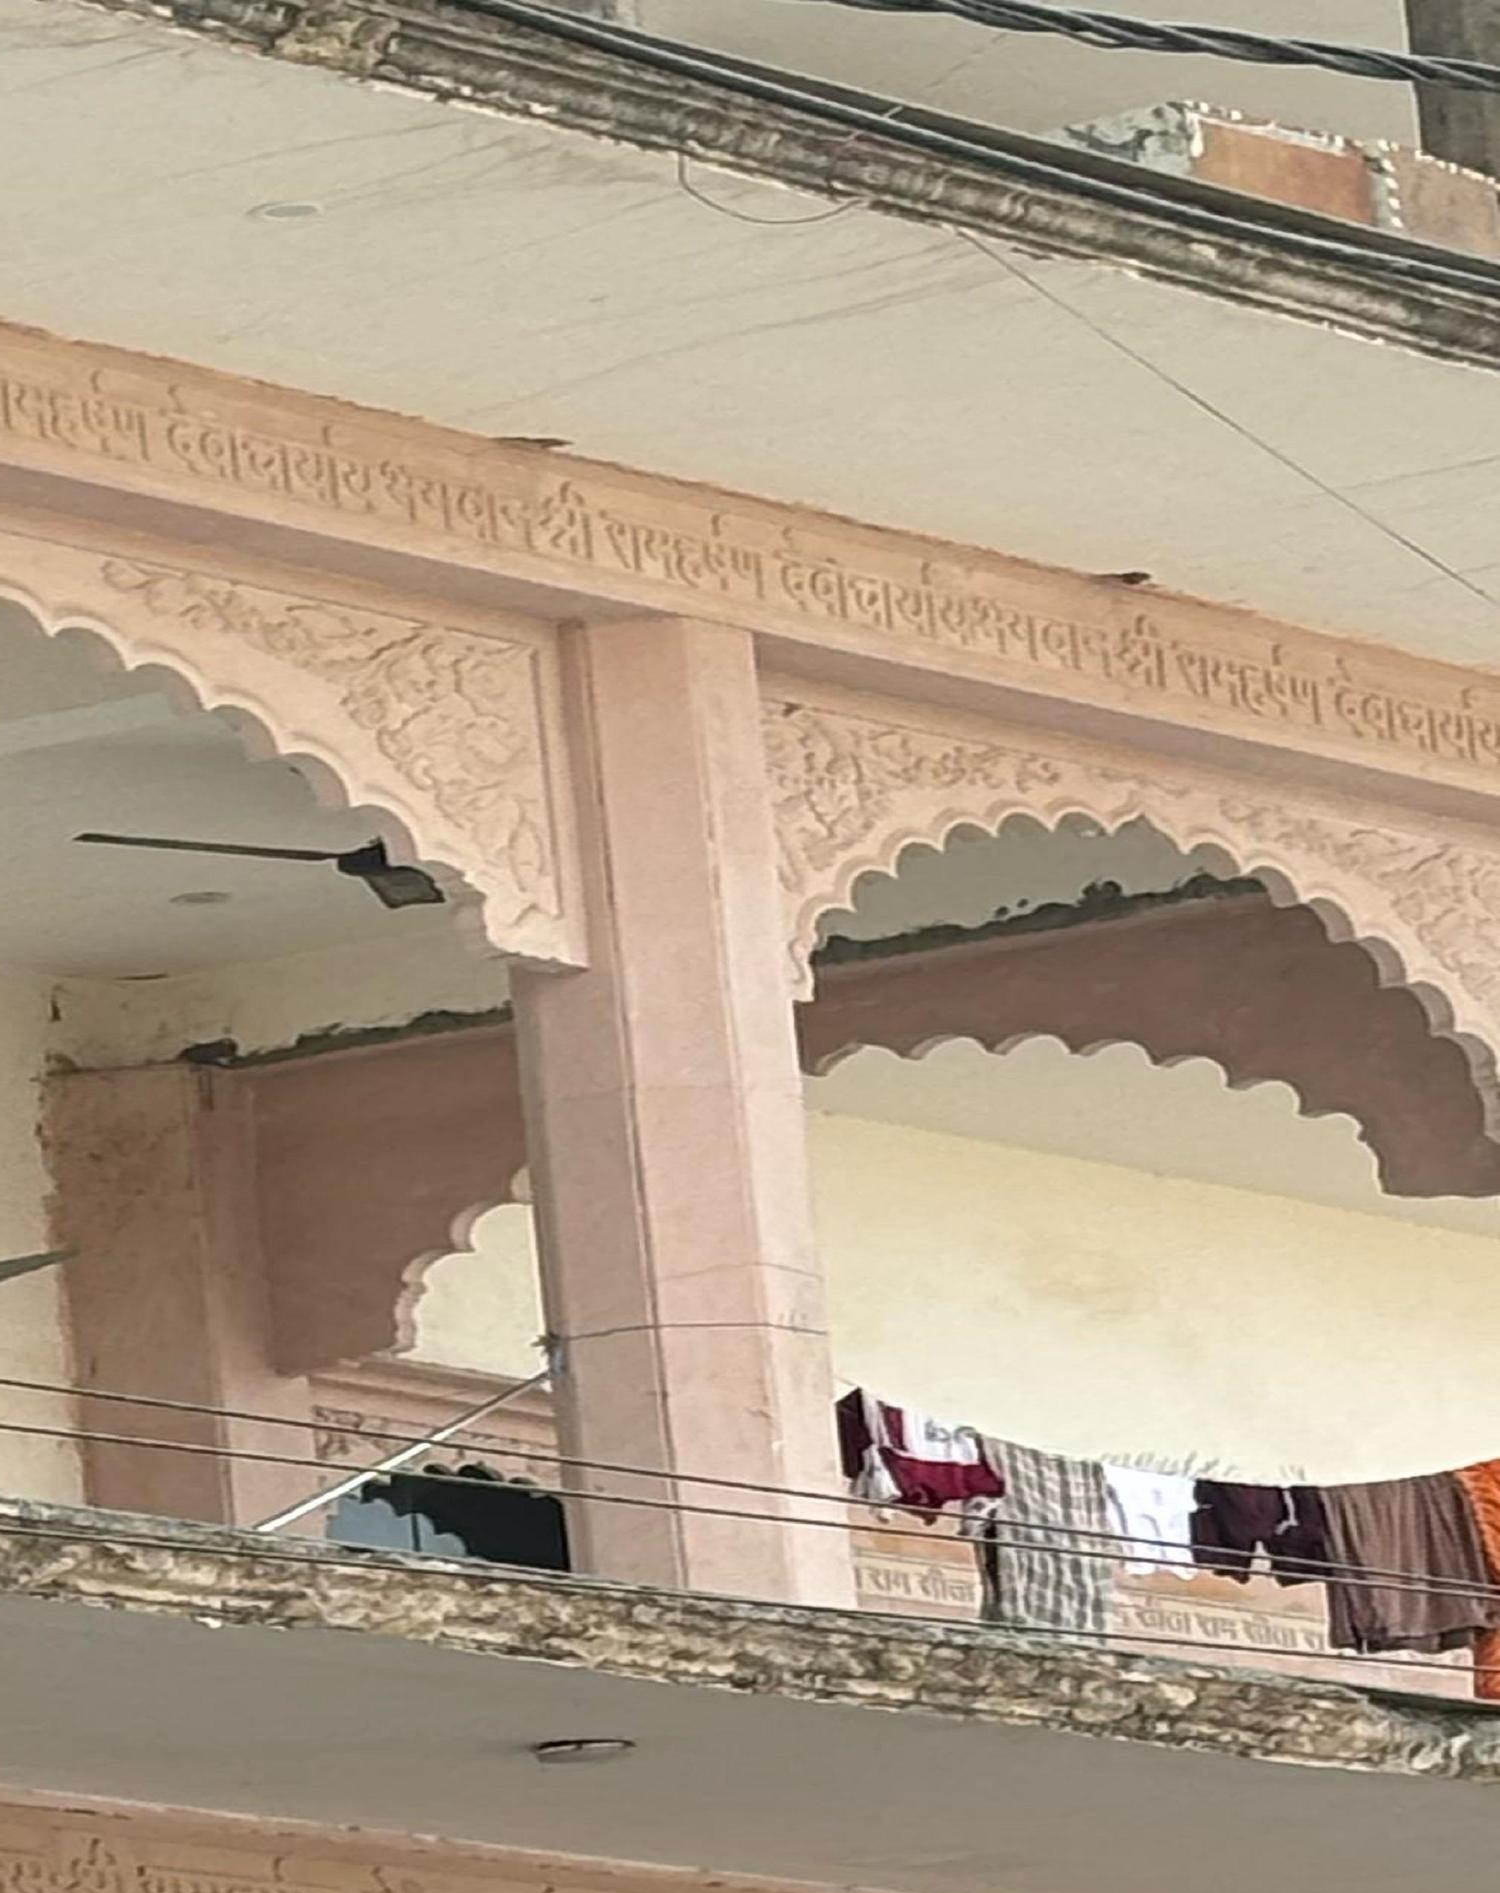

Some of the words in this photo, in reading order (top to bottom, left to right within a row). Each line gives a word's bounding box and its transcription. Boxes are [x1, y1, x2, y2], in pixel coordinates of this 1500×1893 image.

[538, 480, 593, 562] श्री
[600, 510, 765, 600] रामहर्षण
[1115, 613, 1166, 690] श्री
